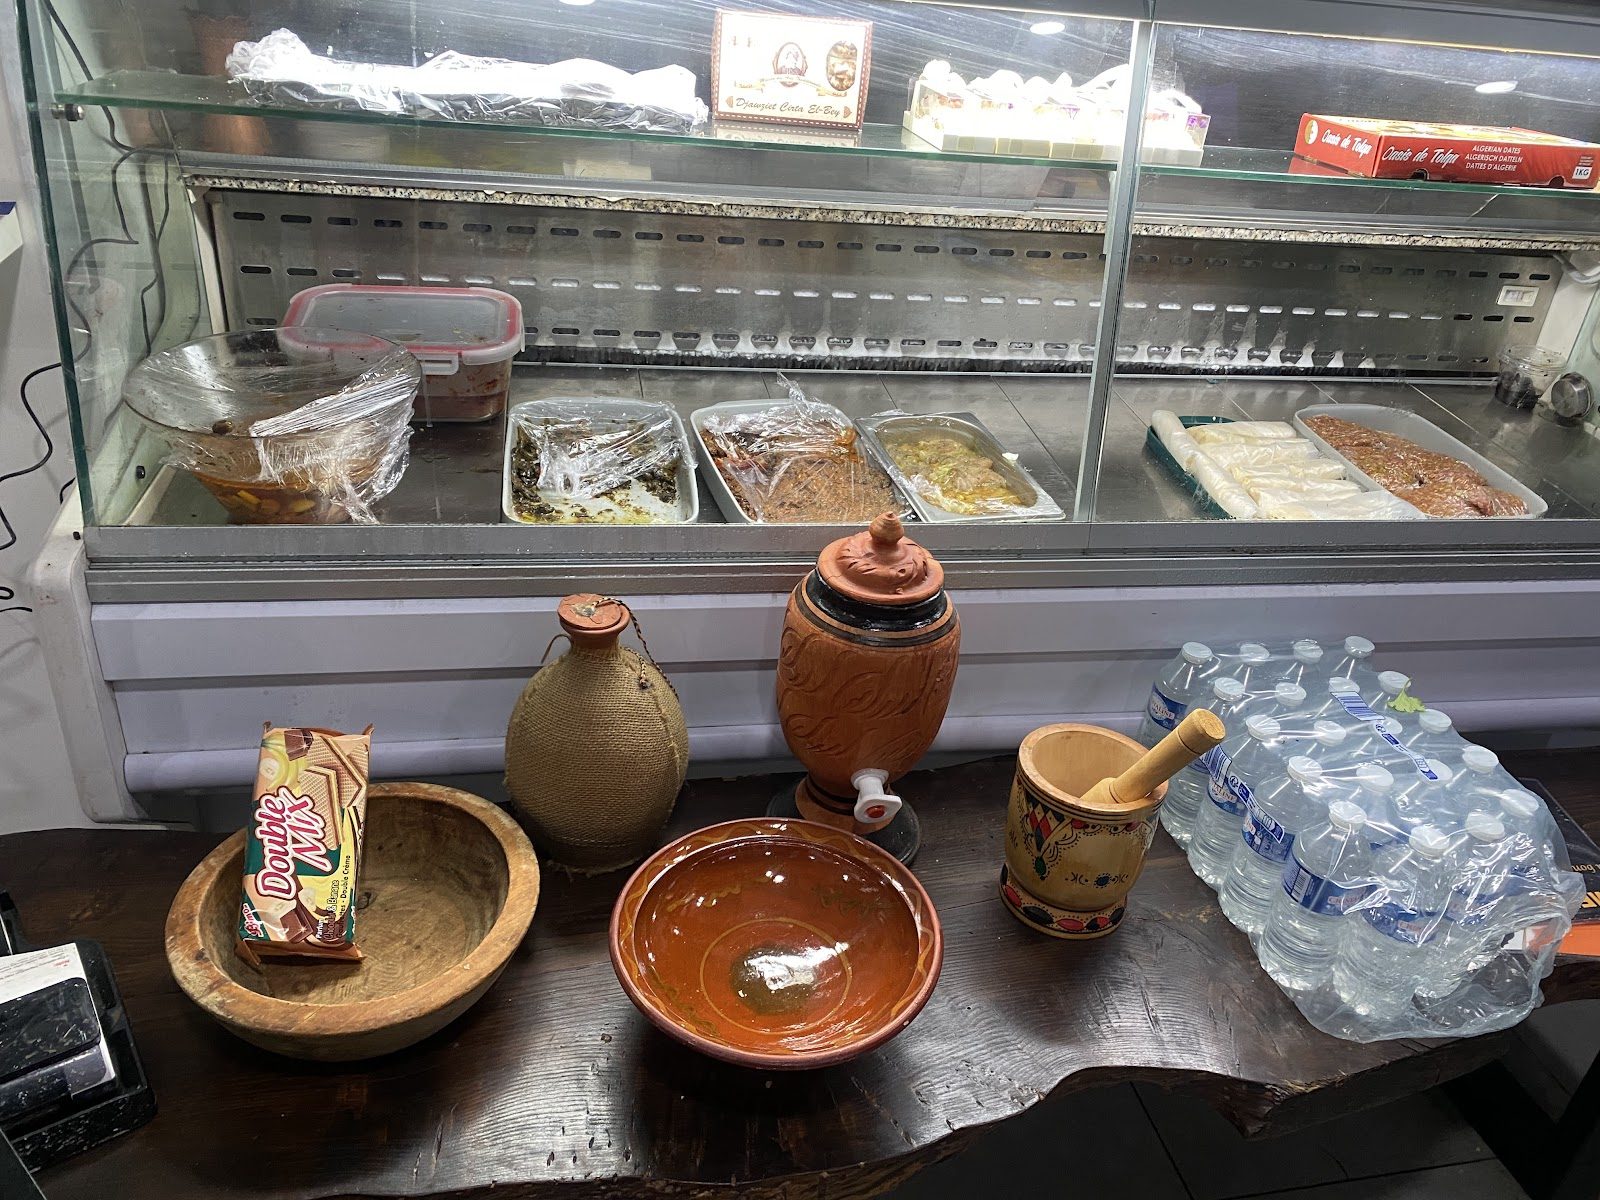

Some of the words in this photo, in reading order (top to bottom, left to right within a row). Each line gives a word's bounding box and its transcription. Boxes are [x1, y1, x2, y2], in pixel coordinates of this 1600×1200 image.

[779, 101, 804, 113] Cirta
[808, 104, 841, 117] El-Bey
[1321, 129, 1341, 146] Oasis
[1340, 135, 1352, 149] de
[1351, 137, 1373, 158] Tolga
[1472, 145, 1503, 153] ALGERIAN
[1381, 146, 1412, 162] Oasis
[1412, 147, 1429, 163] de
[1430, 148, 1460, 169] Tolga
[1465, 153, 1499, 161] ALGERISCH
[1498, 155, 1523, 163] DATTELN
[1465, 162, 1487, 170] DATTES
[1487, 163, 1518, 171] D'ALGERIE
[1575, 168, 1590, 176] 1KG
[281, 787, 329, 868] Mix
[256, 795, 294, 897] Double
[327, 880, 339, 904] Banane
[340, 877, 349, 899] Double
[326, 904, 337, 912] &
[243, 903, 264, 938] Bimo
[316, 917, 324, 939] Parfum
